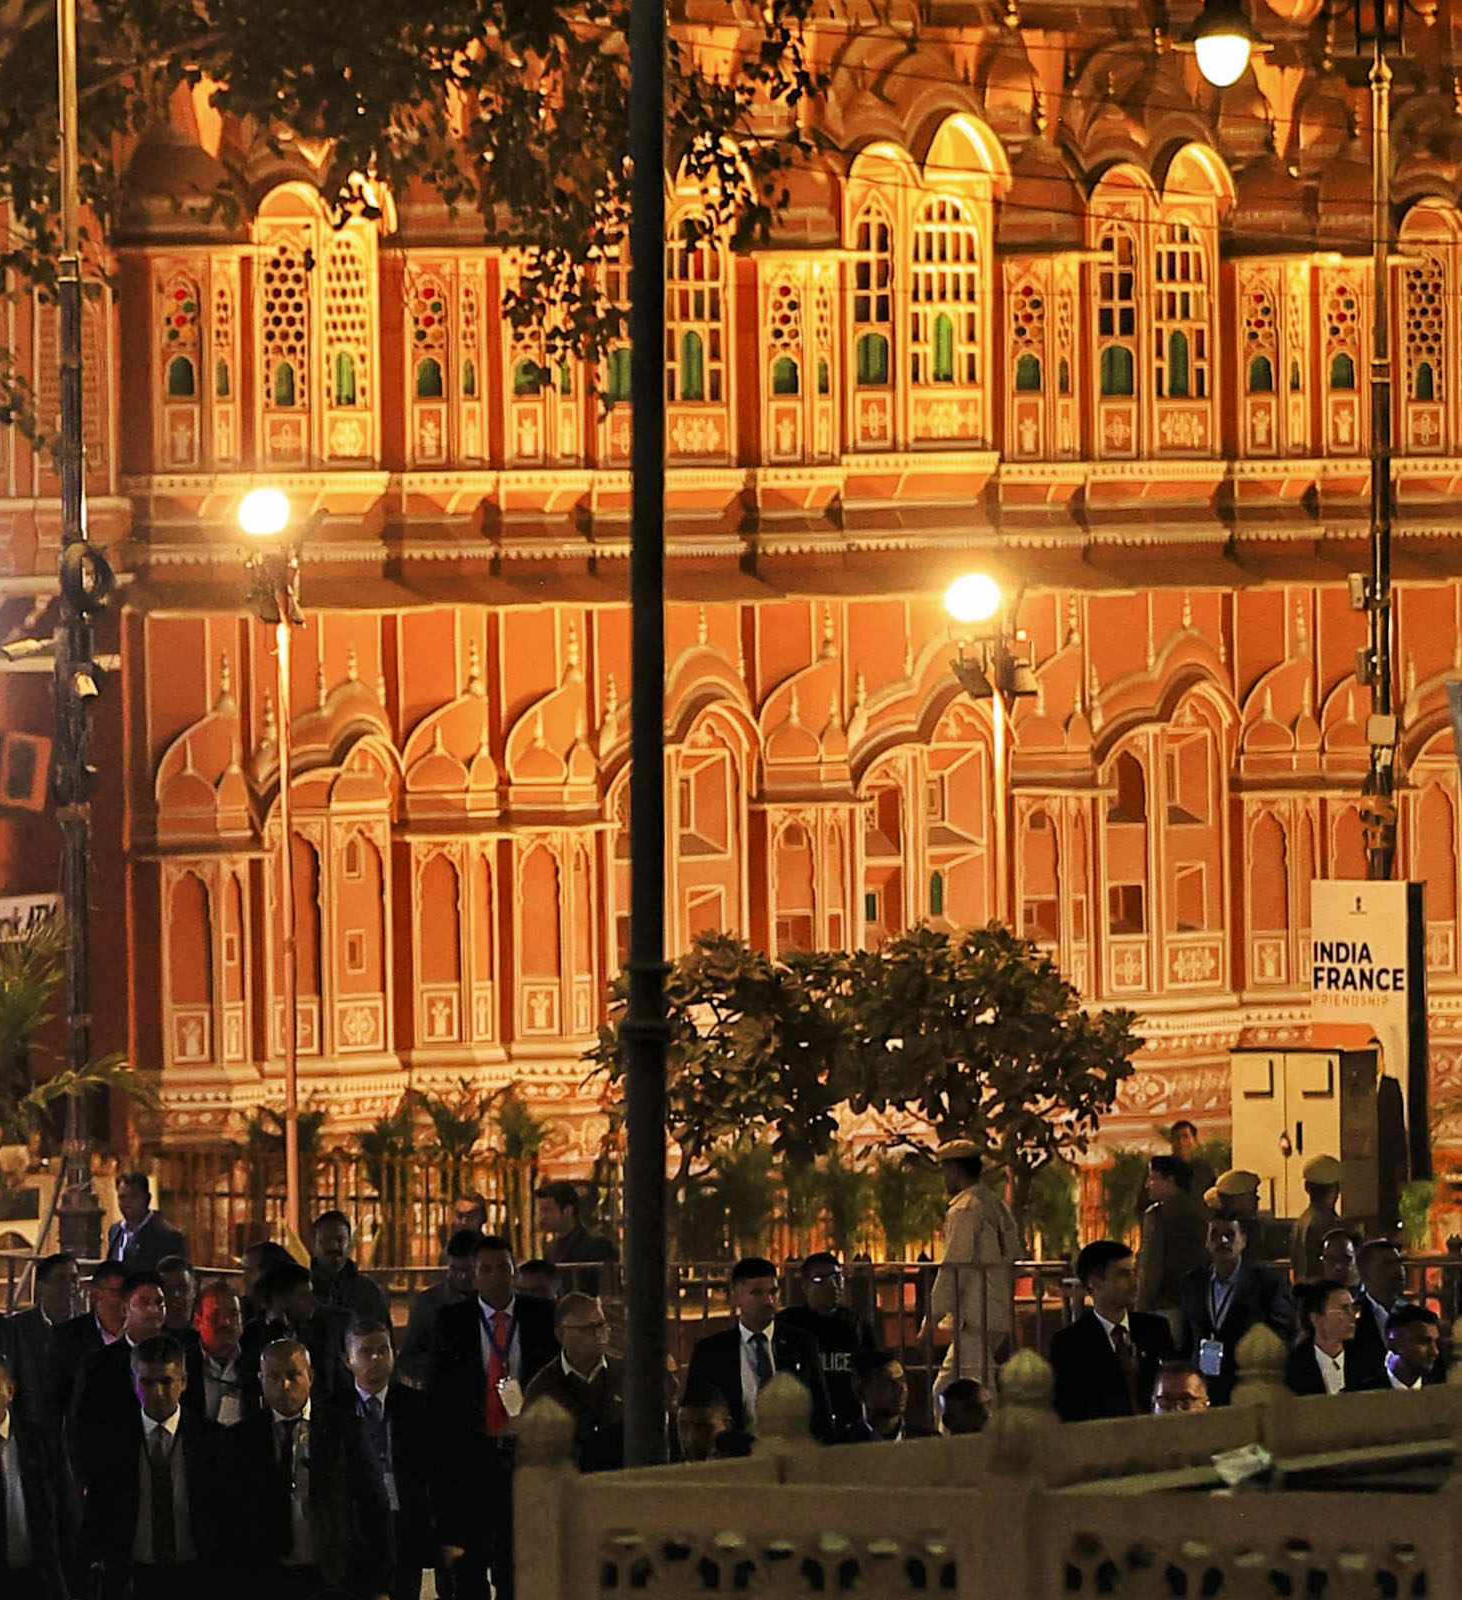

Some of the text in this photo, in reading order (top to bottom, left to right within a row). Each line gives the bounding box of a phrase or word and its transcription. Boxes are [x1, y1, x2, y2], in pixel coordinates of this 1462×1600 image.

[1313, 941, 1372, 964] INDIA
[1313, 966, 1404, 991] FRANCE
[1313, 994, 1388, 1007] FRIENDSHIP
